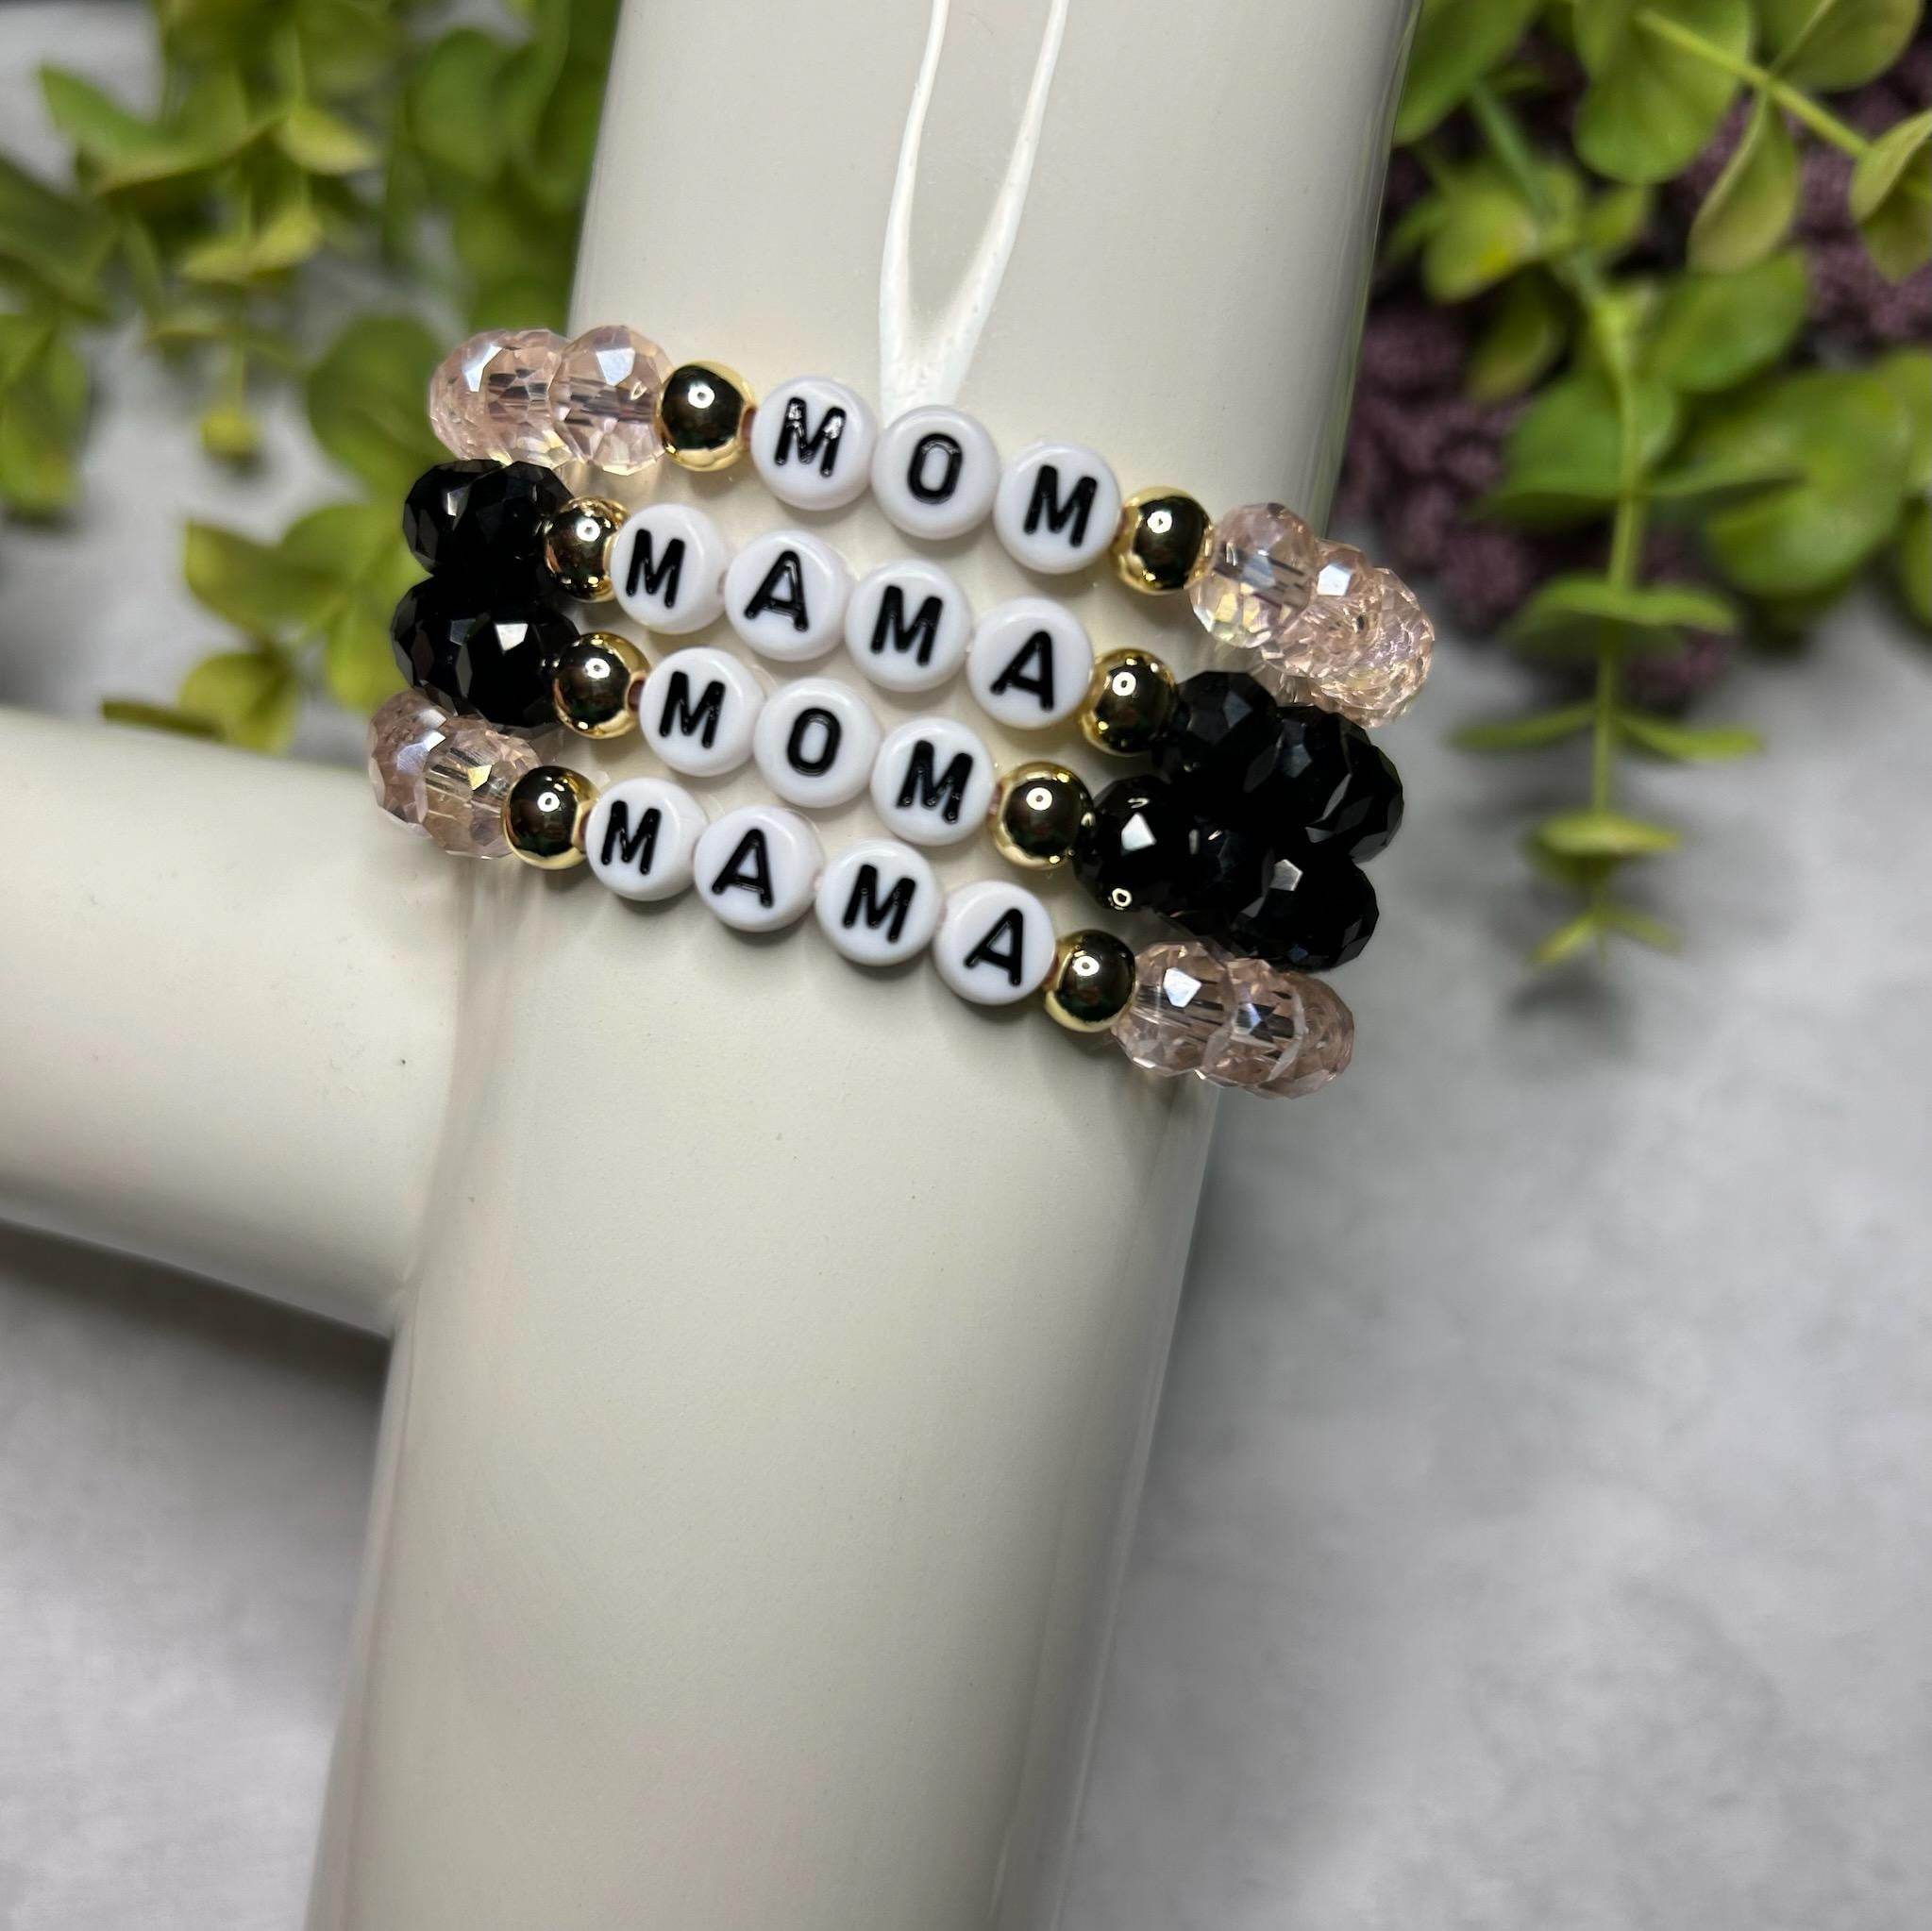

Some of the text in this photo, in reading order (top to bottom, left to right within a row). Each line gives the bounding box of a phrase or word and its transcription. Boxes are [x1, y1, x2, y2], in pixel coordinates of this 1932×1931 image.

[774, 396, 1098, 547] MOM
[625, 529, 1055, 712] MAMA
[659, 671, 974, 823] MOM
[600, 800, 1024, 986] MAMA
